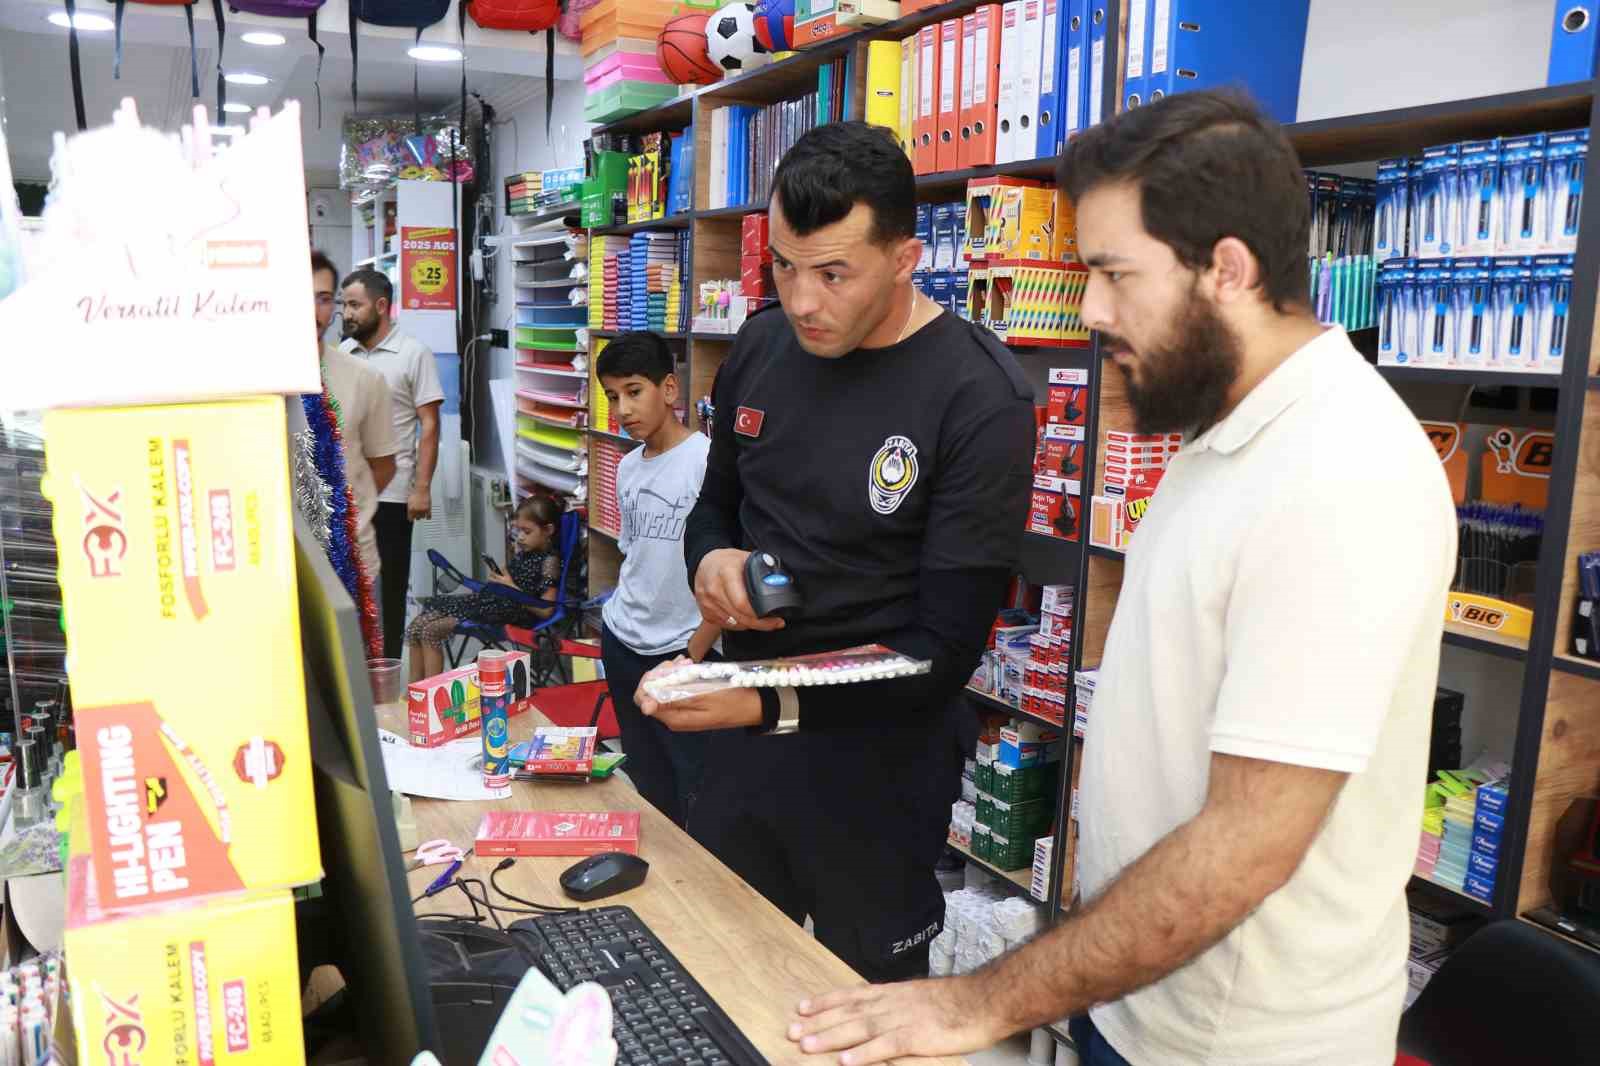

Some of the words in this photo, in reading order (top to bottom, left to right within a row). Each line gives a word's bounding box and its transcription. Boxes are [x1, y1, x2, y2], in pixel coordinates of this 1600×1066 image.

[403, 239, 431, 249] 2025
[427, 267, 442, 280] 25
[149, 439, 167, 507] KALEM
[154, 515, 176, 619] FOSFORLU
[97, 724, 148, 899] HI-LIGHTING
[145, 819, 190, 894] PEN
[892, 921, 940, 954] ZABITA
[165, 943, 184, 1004] KALEM
